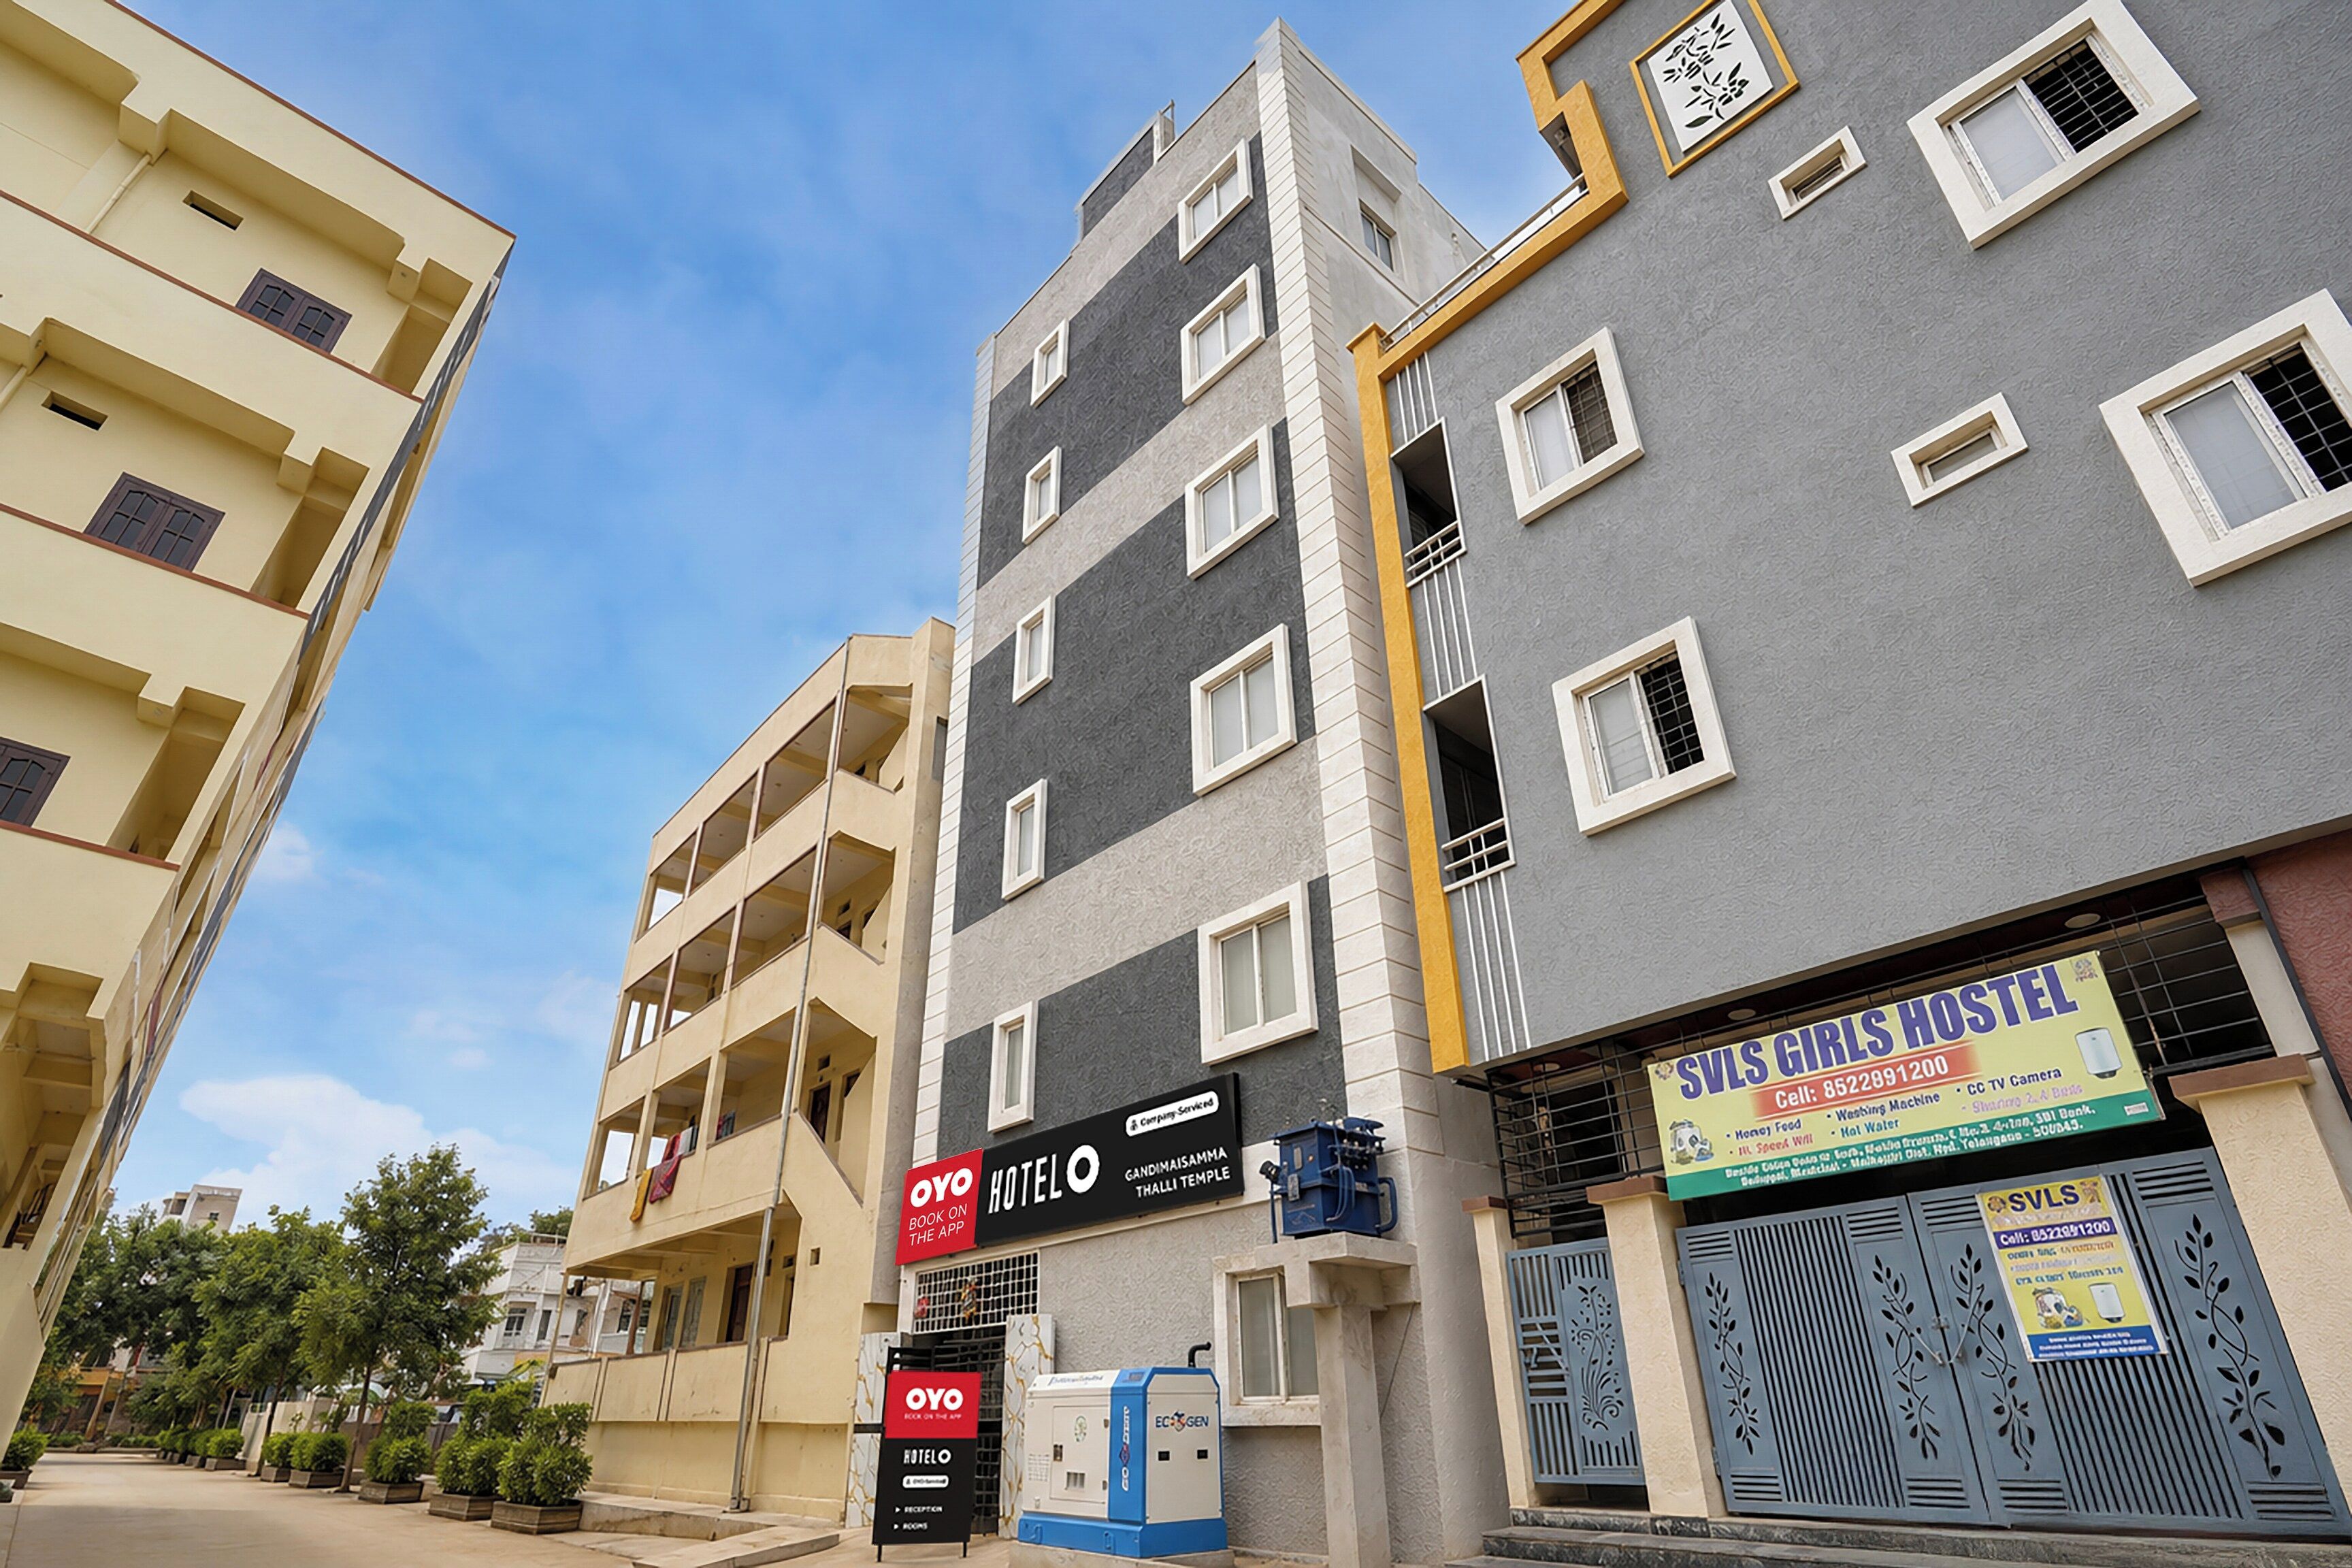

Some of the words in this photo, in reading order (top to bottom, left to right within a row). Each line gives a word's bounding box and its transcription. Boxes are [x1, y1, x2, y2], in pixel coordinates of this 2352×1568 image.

[1676, 1041, 1768, 1100] SVLS
[1774, 1009, 1894, 1078] GIRLS
[1897, 964, 2078, 1049] HOSTEL
[1775, 1088, 1817, 1109] Cell:
[1824, 1055, 1948, 1100] 8522891200
[1967, 1082, 1985, 1096] CC
[1988, 1077, 2005, 1091] TV
[2010, 1068, 2062, 1087] Camera
[1835, 1102, 1886, 1122] Washing
[1889, 1092, 1940, 1113] Machine
[1865, 1118, 1899, 1134] Water
[1125, 1146, 1228, 1181] GANDIMAISAMMA
[910, 1167, 973, 1208] OYO
[1136, 1177, 1177, 1198] THALLI
[1179, 1166, 1230, 1189] TEMPLE
[2008, 1184, 2080, 1212] SVLS
[909, 1209, 945, 1230] BOOK
[948, 1203, 968, 1220] ON
[909, 1228, 935, 1246] THE
[938, 1220, 964, 1239] APP
[906, 1388, 964, 1411] OYO
[902, 1522, 928, 1530] ROOMS
